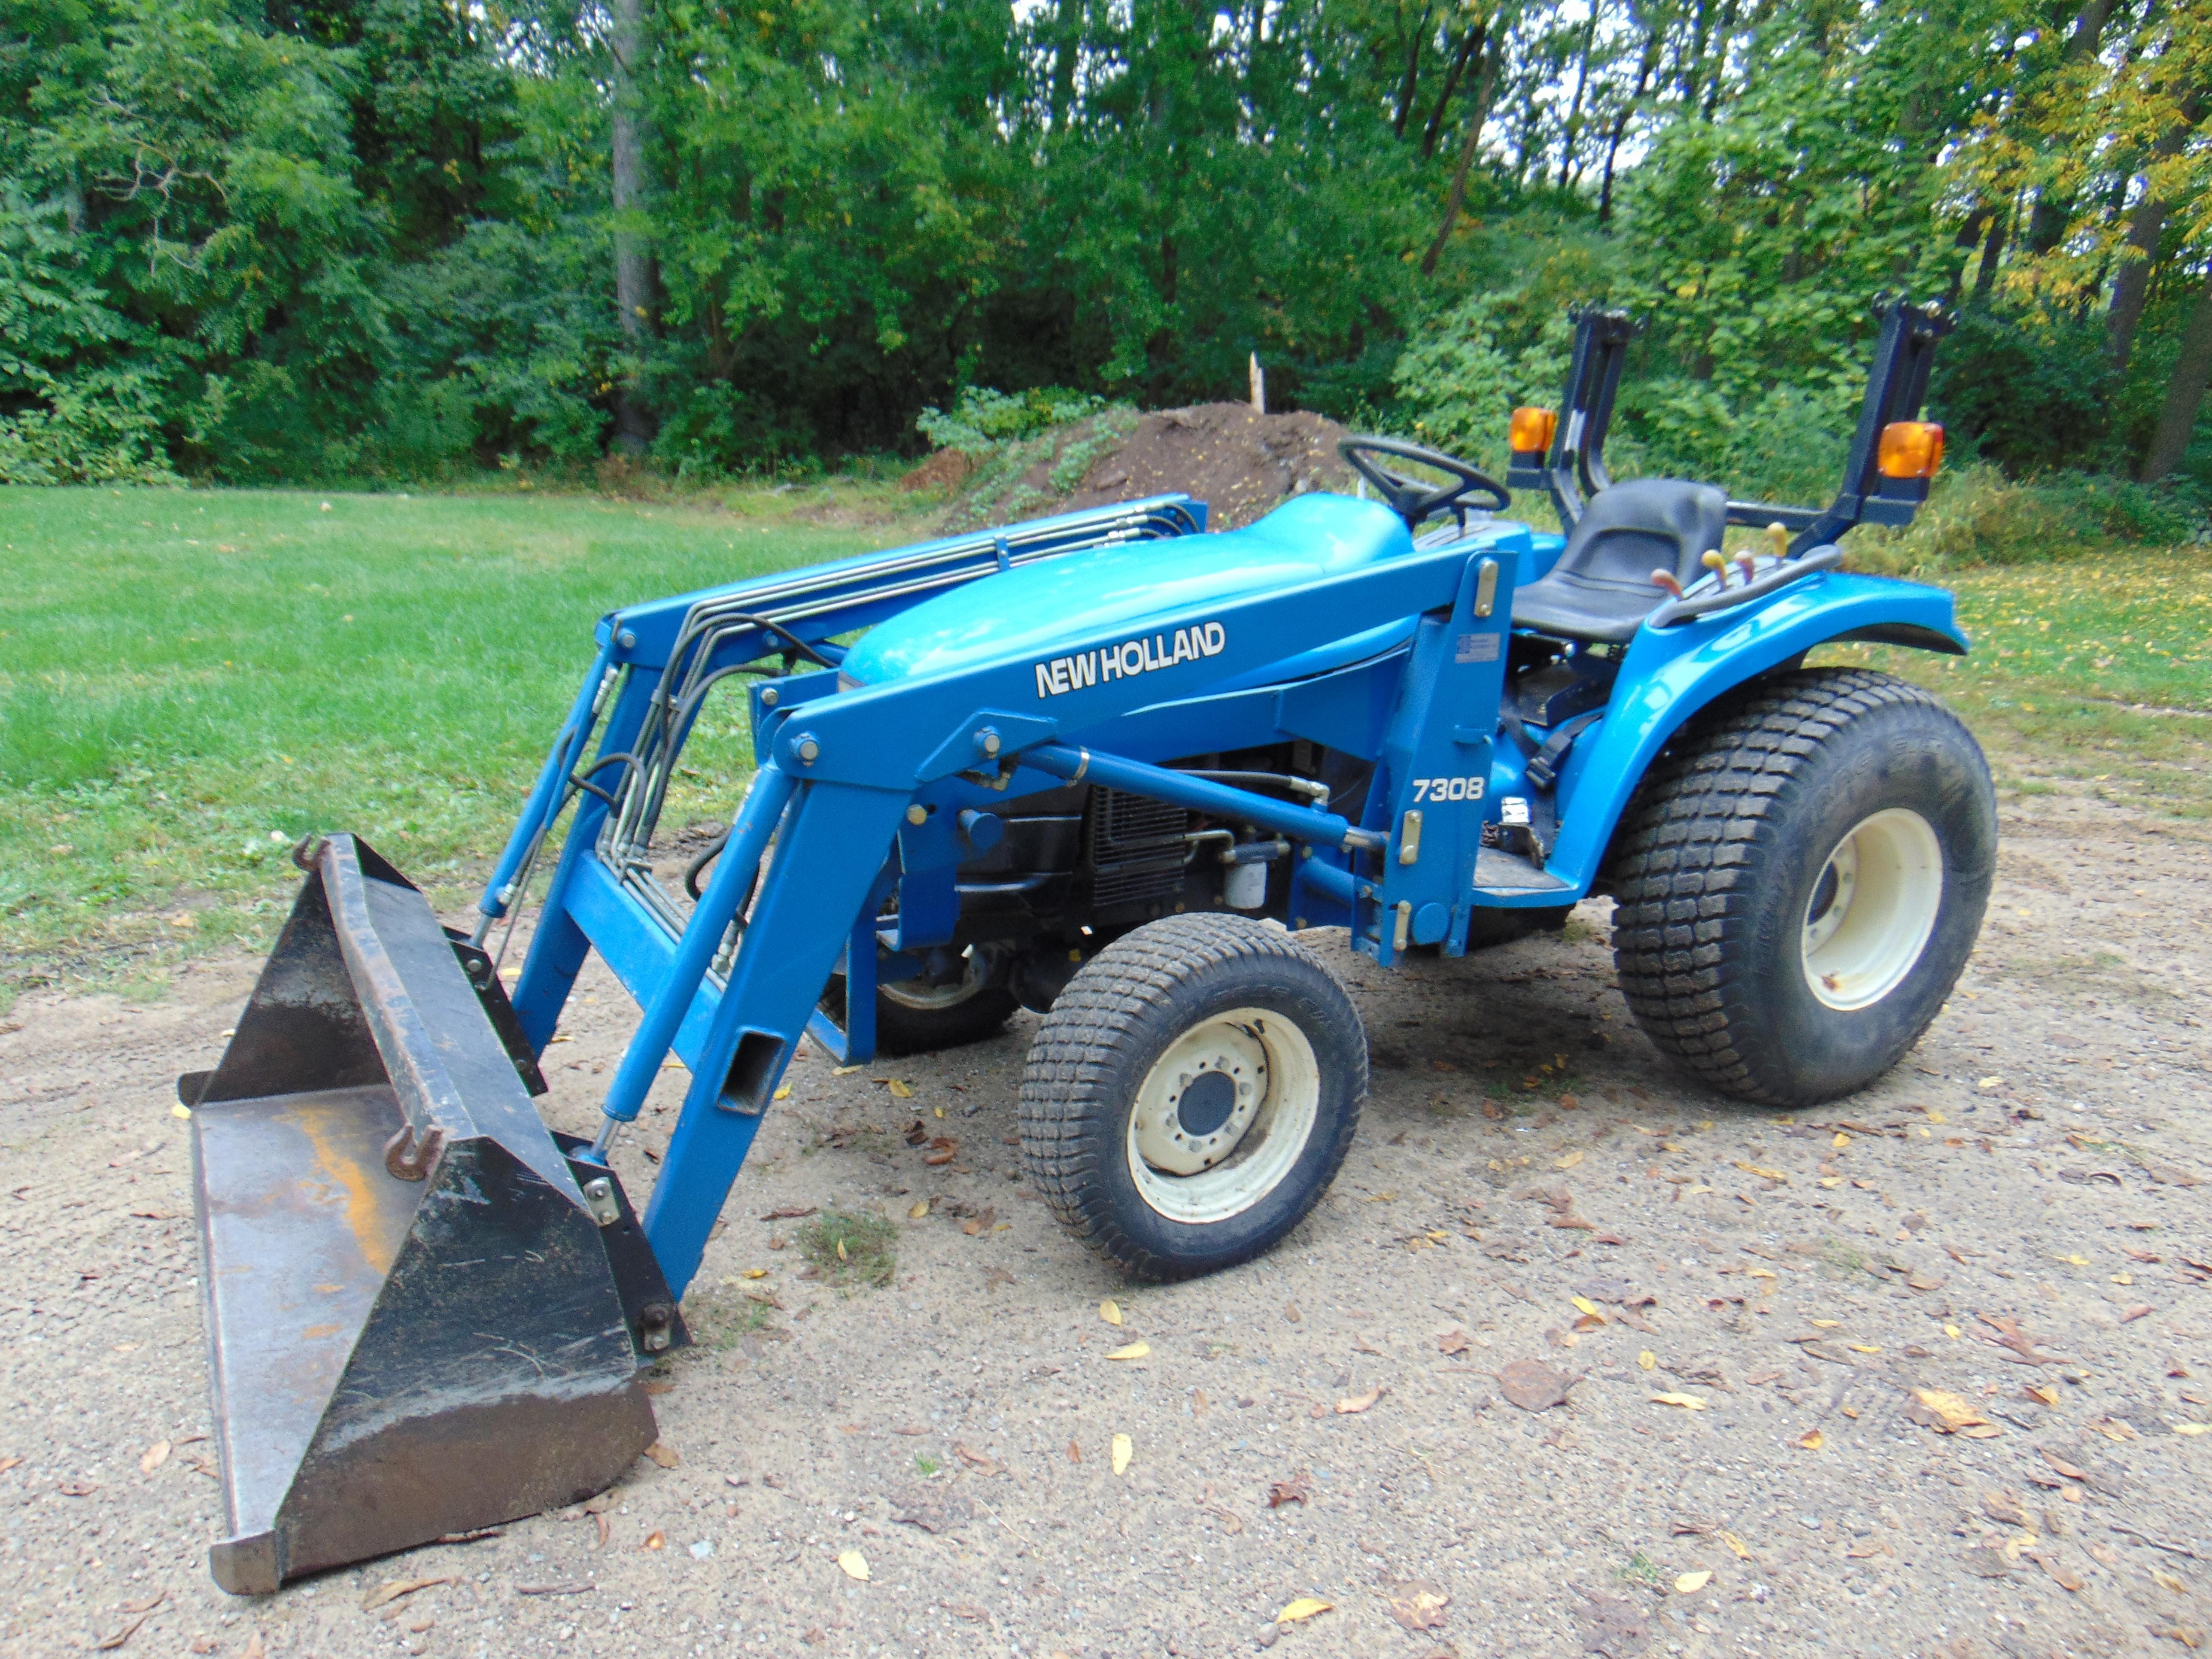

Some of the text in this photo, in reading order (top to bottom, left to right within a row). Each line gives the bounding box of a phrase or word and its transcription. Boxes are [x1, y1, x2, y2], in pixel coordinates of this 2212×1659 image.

[1035, 621, 1226, 698] NEW HOLLAND
[1413, 777, 1484, 803] 7308
